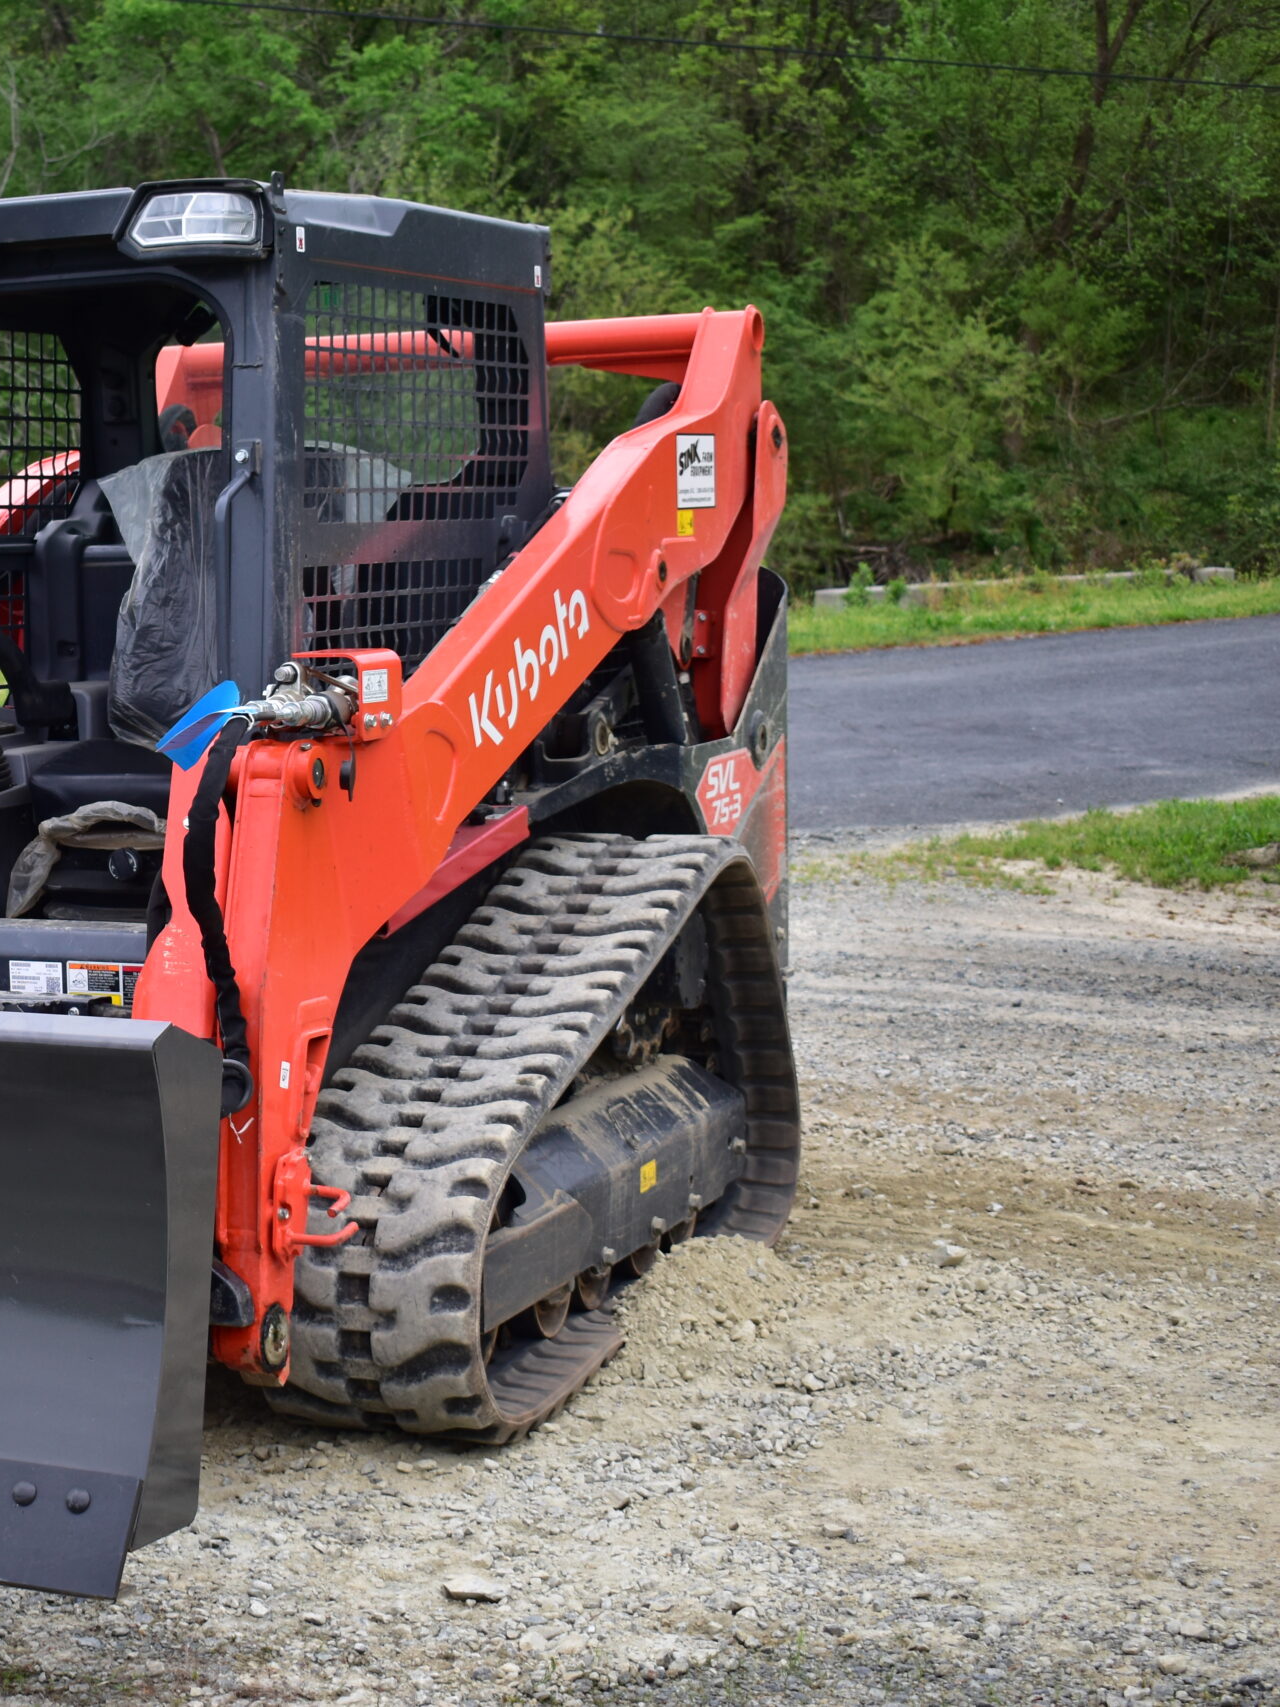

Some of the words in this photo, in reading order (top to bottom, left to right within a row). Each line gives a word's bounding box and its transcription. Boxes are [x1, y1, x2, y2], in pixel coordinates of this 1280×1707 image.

[679, 438, 701, 477] SINK
[468, 588, 590, 748] Kubota
[705, 759, 741, 799] SVL
[712, 793, 742, 826] 75-3
